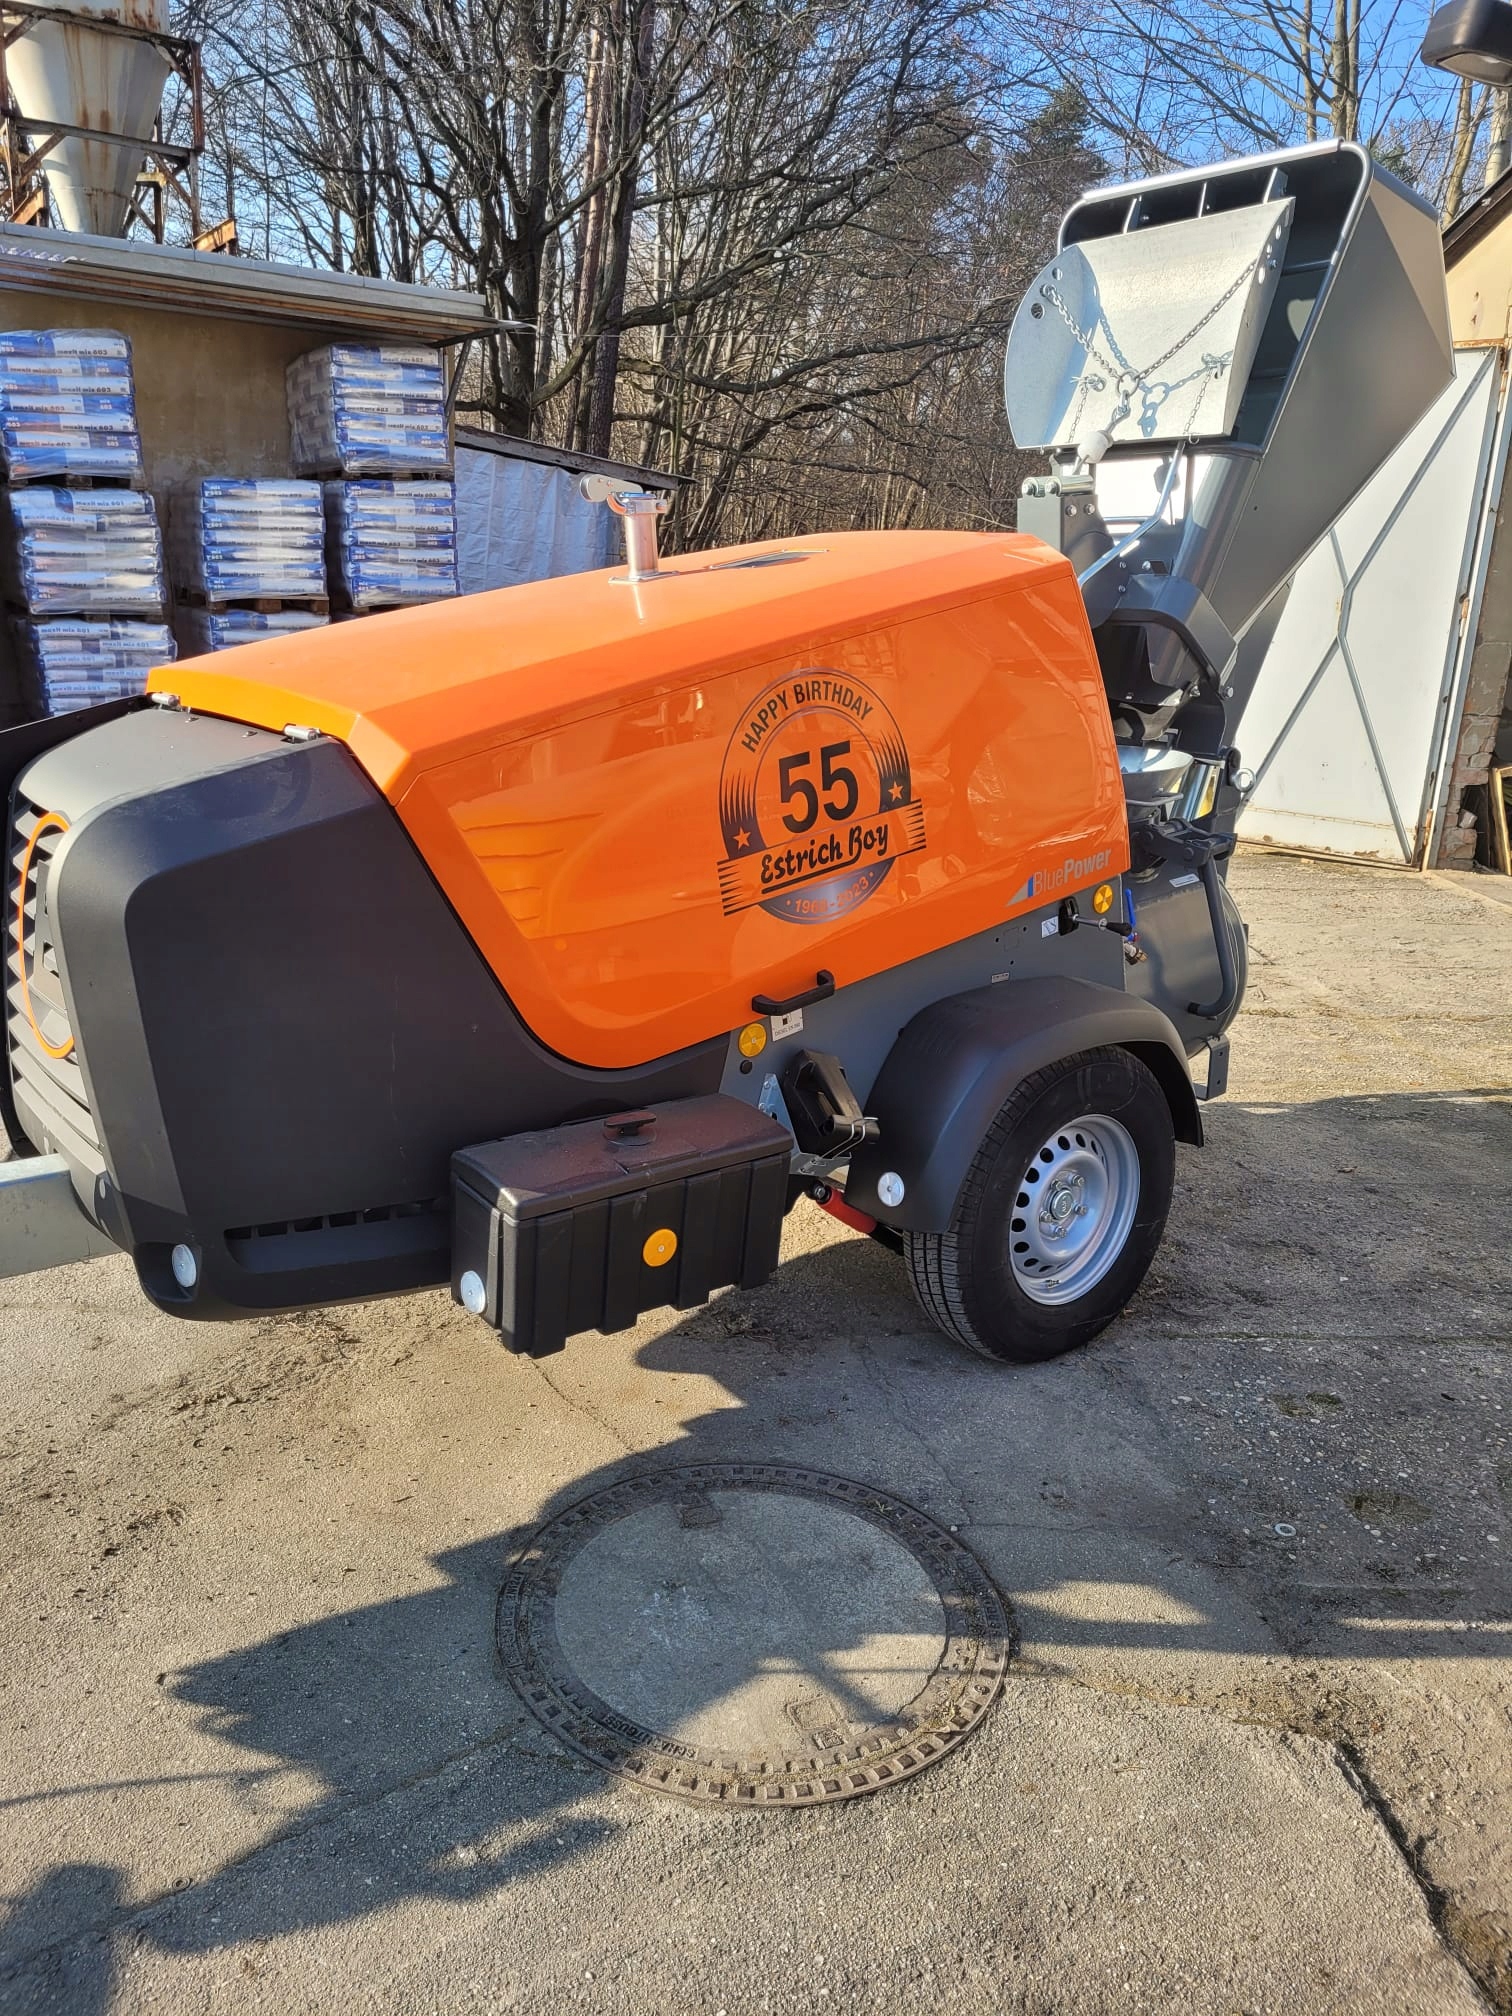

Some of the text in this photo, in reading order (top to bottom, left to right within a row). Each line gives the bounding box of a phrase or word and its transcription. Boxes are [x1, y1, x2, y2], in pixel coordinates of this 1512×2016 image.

[741, 680, 874, 753] HAPPY BIRTHDAY
[778, 740, 859, 834] 55
[760, 823, 889, 884] Estrich Boy
[1033, 848, 1112, 896] BluePower
